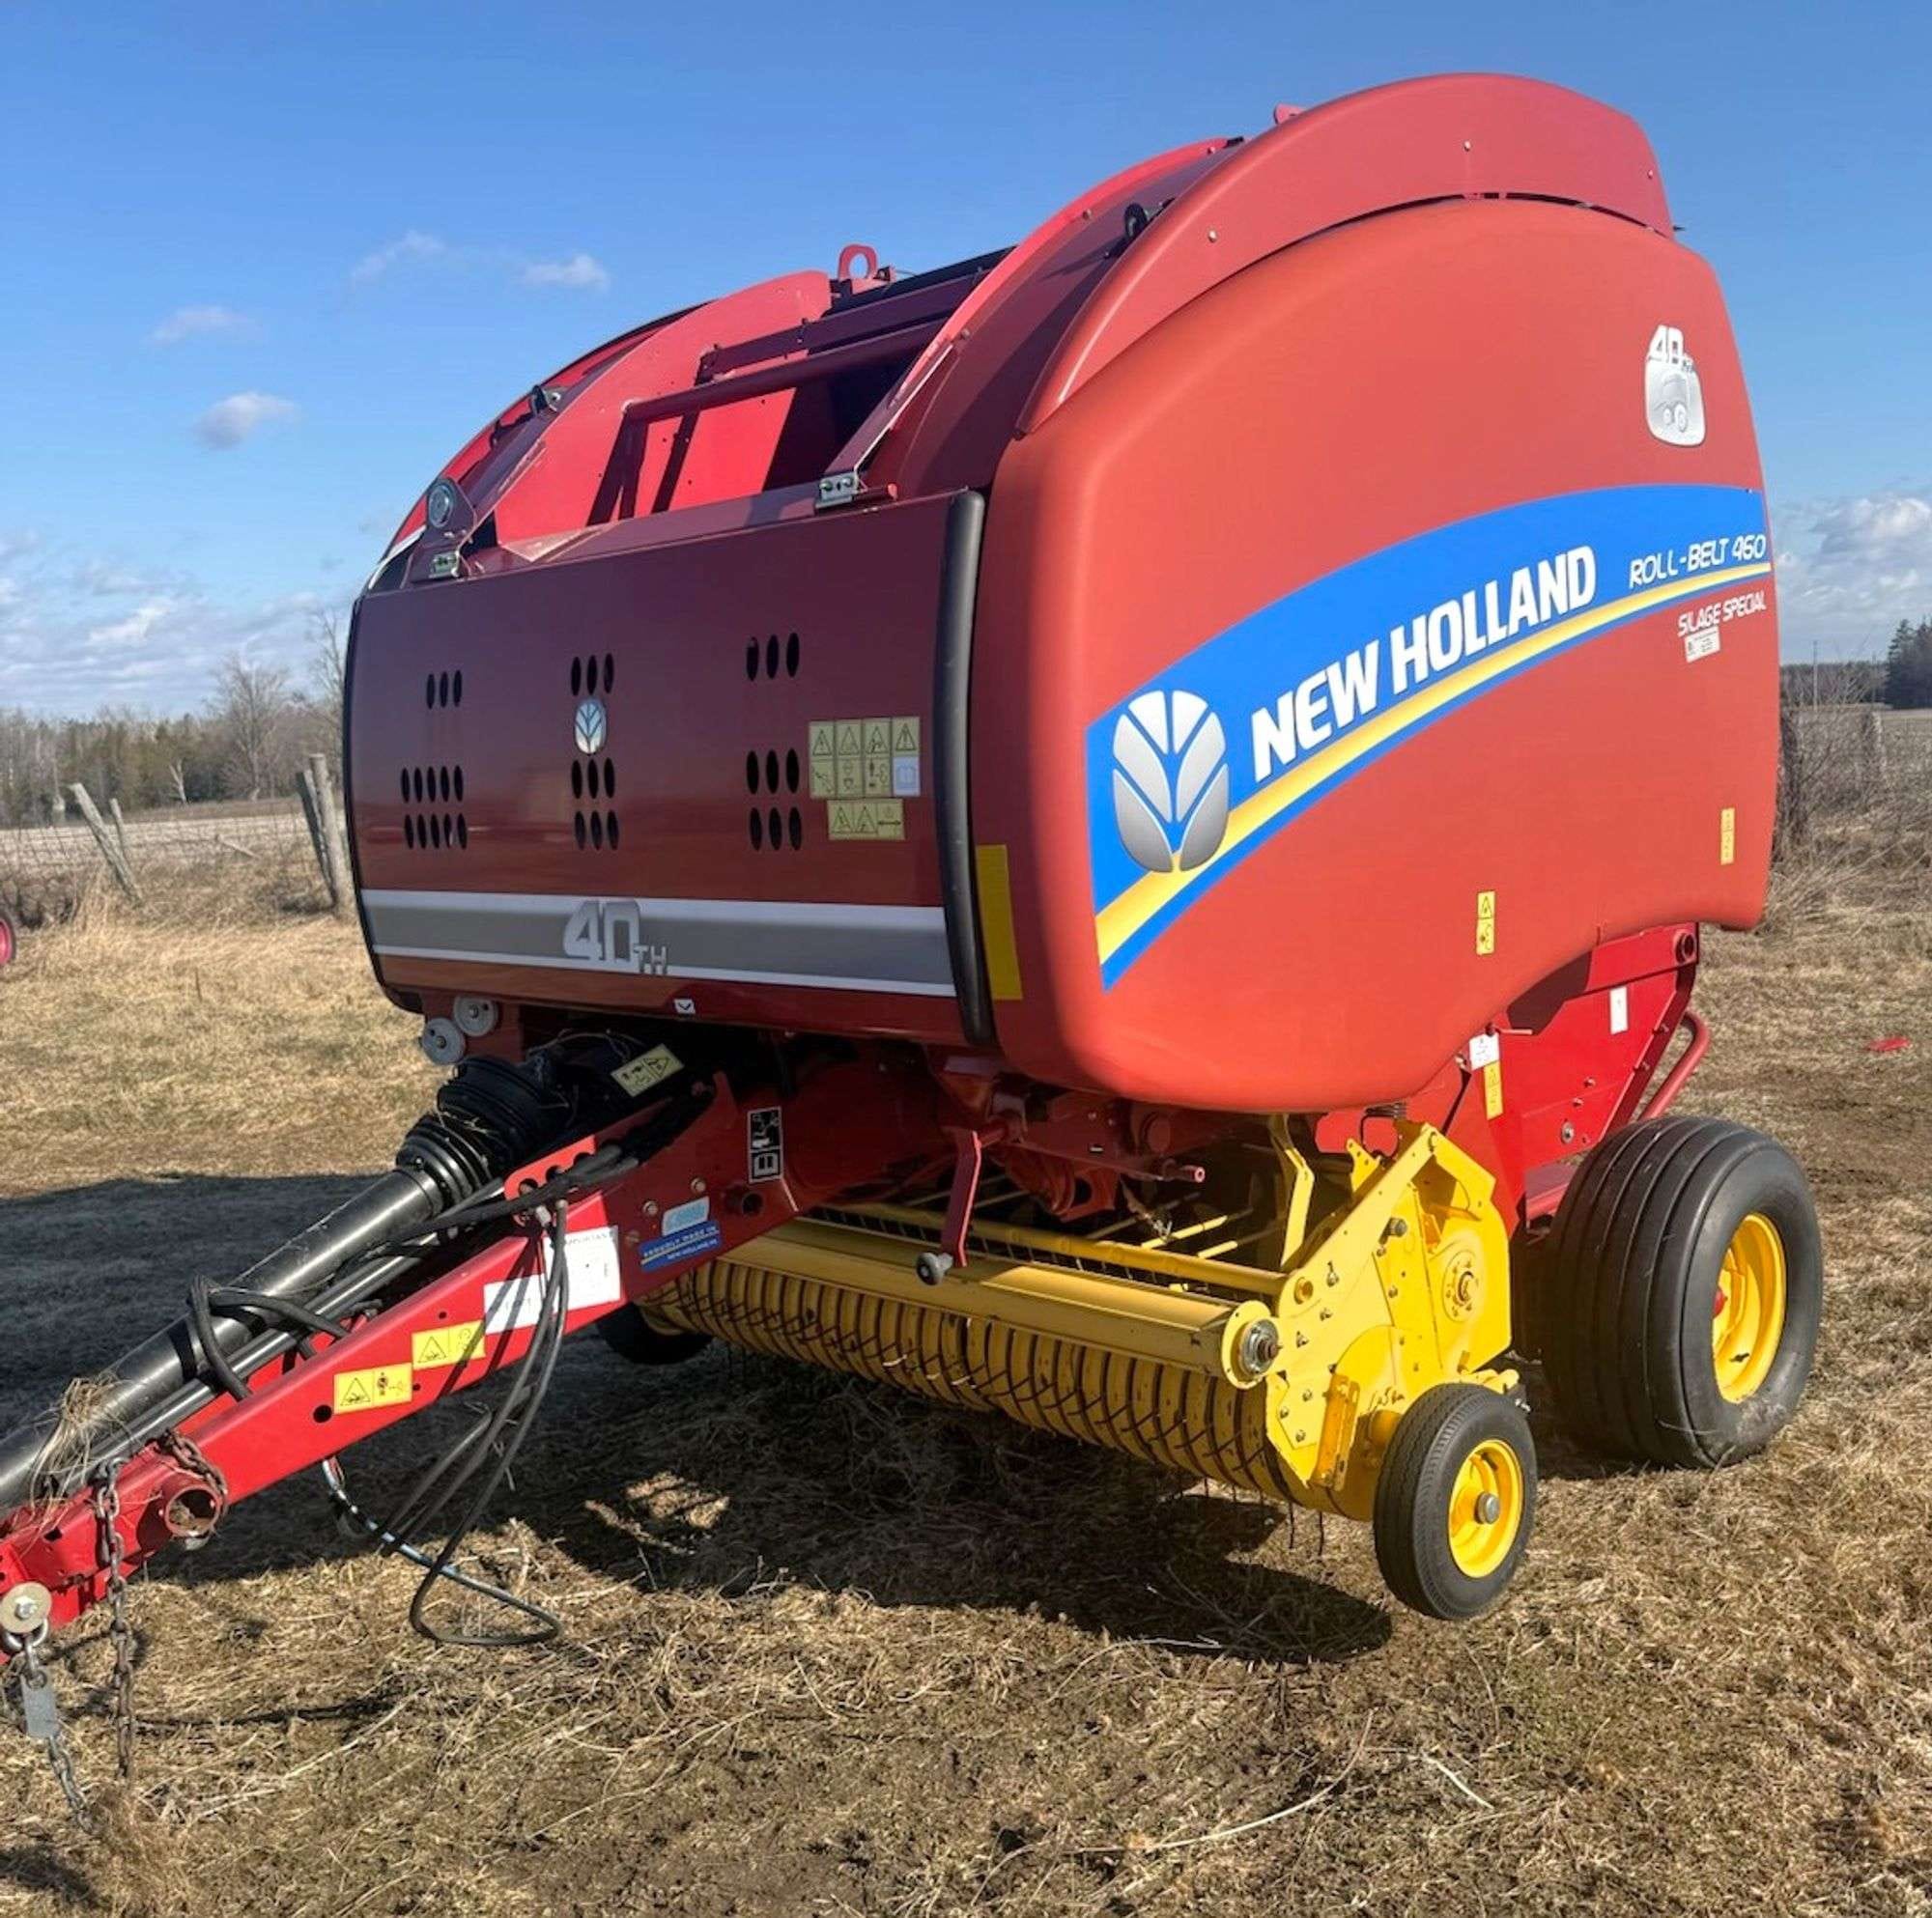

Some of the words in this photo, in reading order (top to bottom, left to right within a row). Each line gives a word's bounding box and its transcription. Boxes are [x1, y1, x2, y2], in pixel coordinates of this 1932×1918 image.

[1630, 537, 1730, 589] ROLL-BELT
[1731, 534, 1767, 561] 460
[1677, 602, 1722, 637] SILAGE
[1722, 590, 1767, 622] SPECIAL
[1251, 638, 1379, 783] NEW
[1389, 545, 1596, 695] HOLLAND
